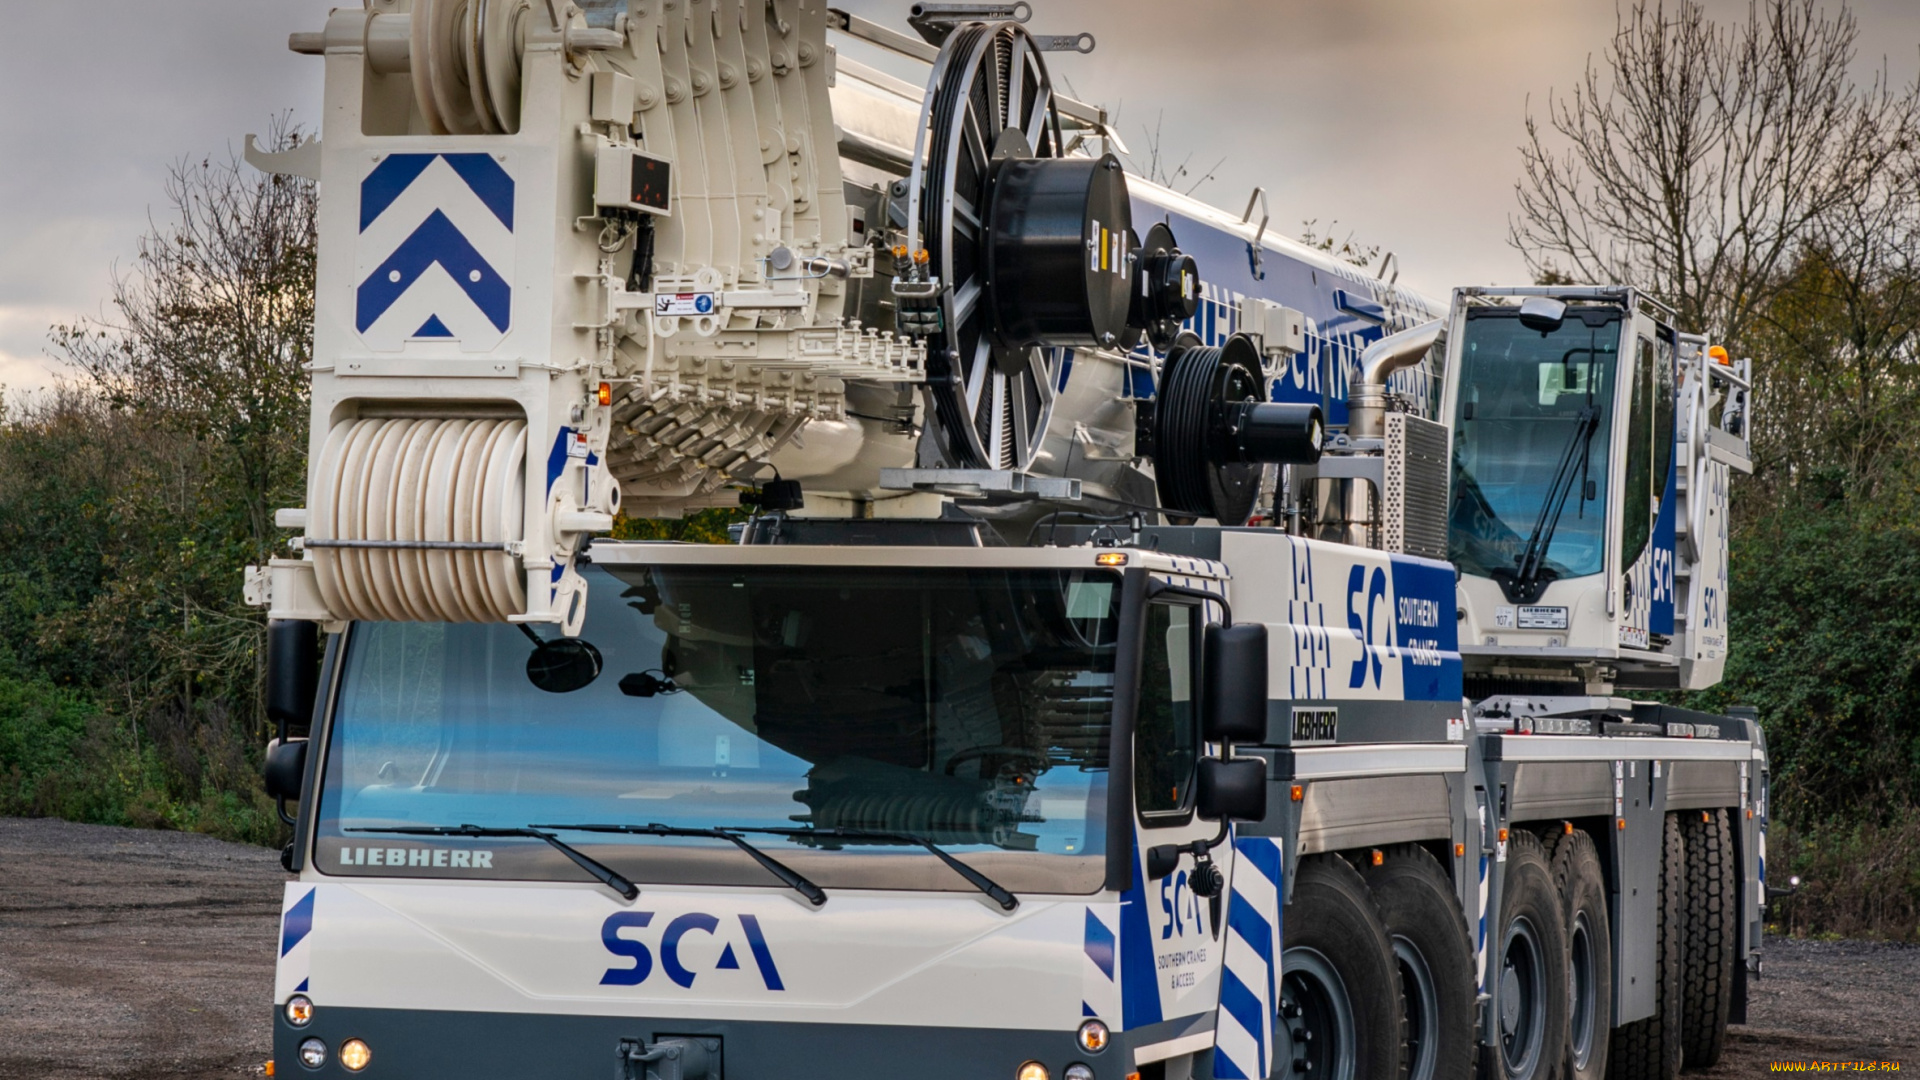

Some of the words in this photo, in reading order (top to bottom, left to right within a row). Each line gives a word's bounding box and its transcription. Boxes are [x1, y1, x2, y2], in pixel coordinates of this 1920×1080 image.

[1653, 547, 1674, 604] SCA
[1398, 596, 1439, 628] SOUTHERN
[1704, 587, 1718, 629] SCA
[1347, 564, 1397, 692] SCA
[1408, 638, 1441, 667] CRANES
[1292, 711, 1337, 741] LIEBHERR
[340, 847, 493, 868] LIEBHERR
[598, 910, 785, 991] SCA
[1158, 952, 1186, 970] SOUTHERN
[1186, 948, 1207, 965] CRANES
[1175, 972, 1195, 988] ACCESS
